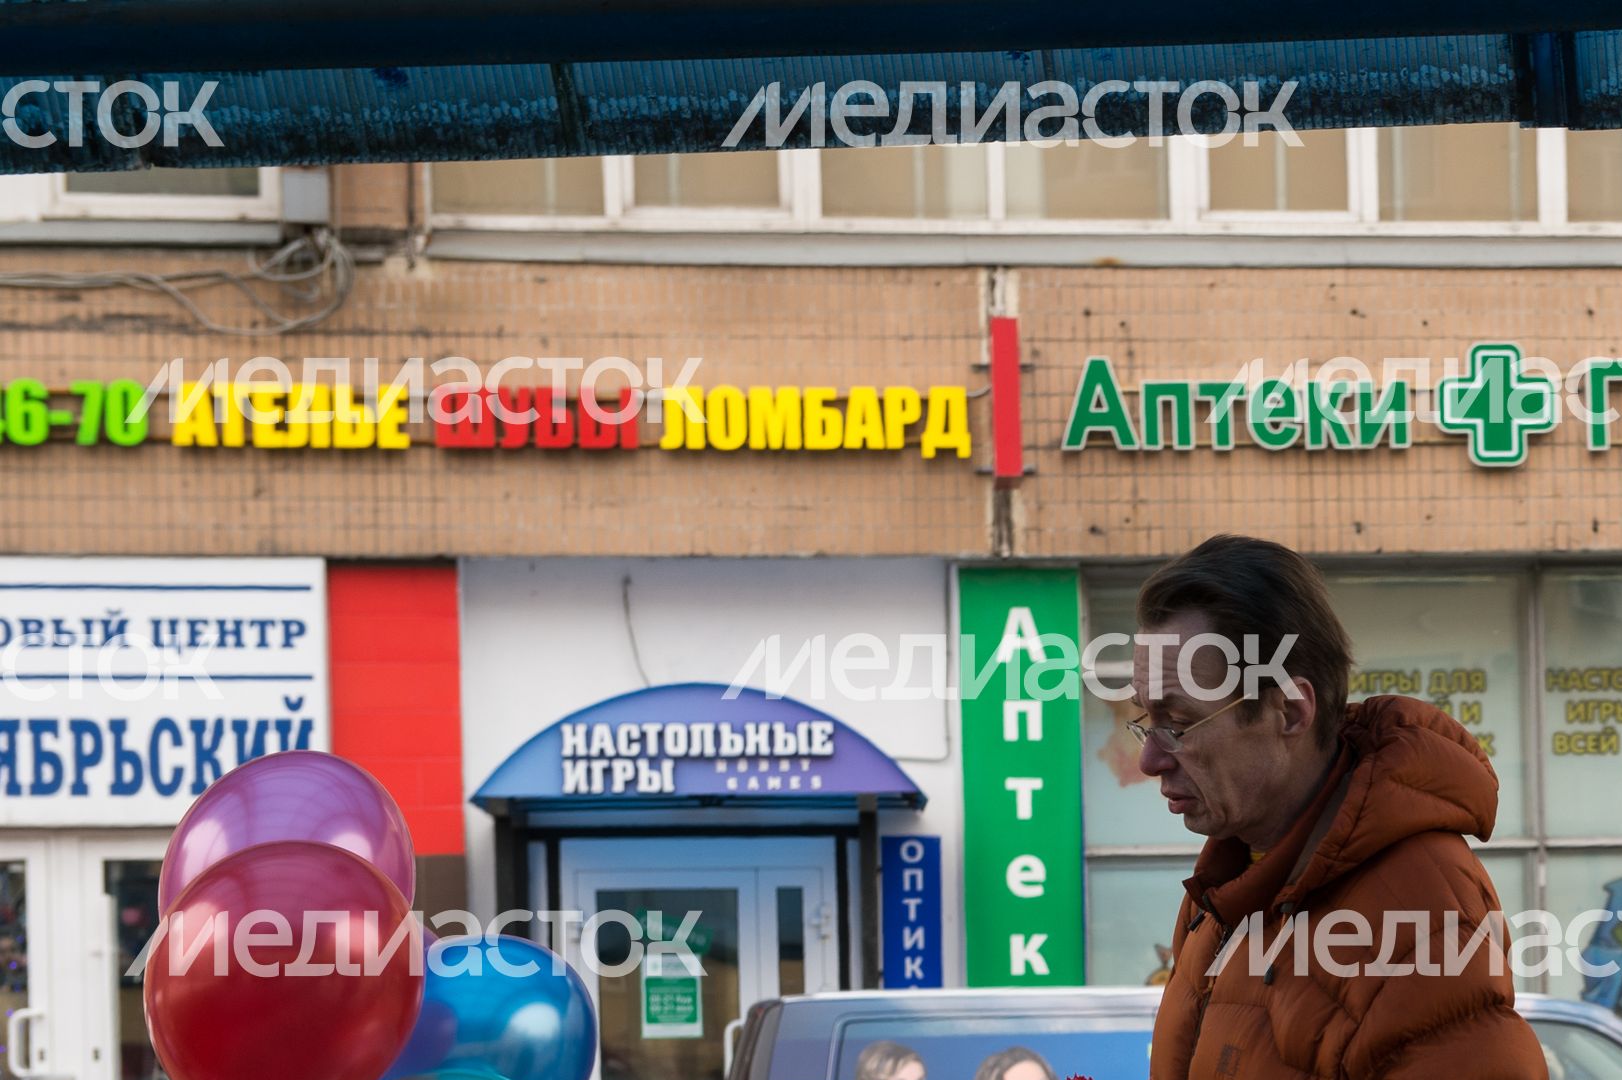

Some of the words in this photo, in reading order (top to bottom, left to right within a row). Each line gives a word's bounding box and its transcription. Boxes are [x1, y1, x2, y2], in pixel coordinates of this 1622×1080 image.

[0, 378, 148, 446] 6-70
[172, 381, 411, 448] АТЕЛЬЕ
[434, 386, 639, 448] ШУБЫ
[660, 385, 971, 458] ЛОМБАРД
[1061, 356, 1411, 452] Аптеки
[150, 617, 307, 655] ЦЕНТР
[1427, 669, 1487, 695] ДЛЯ
[560, 721, 834, 758] НАСТОЛЬНЫЕ
[1552, 725, 1620, 755] ВСЕЙ
[561, 758, 675, 794] ИГРЫ
[900, 838, 926, 989] ОПТИК
